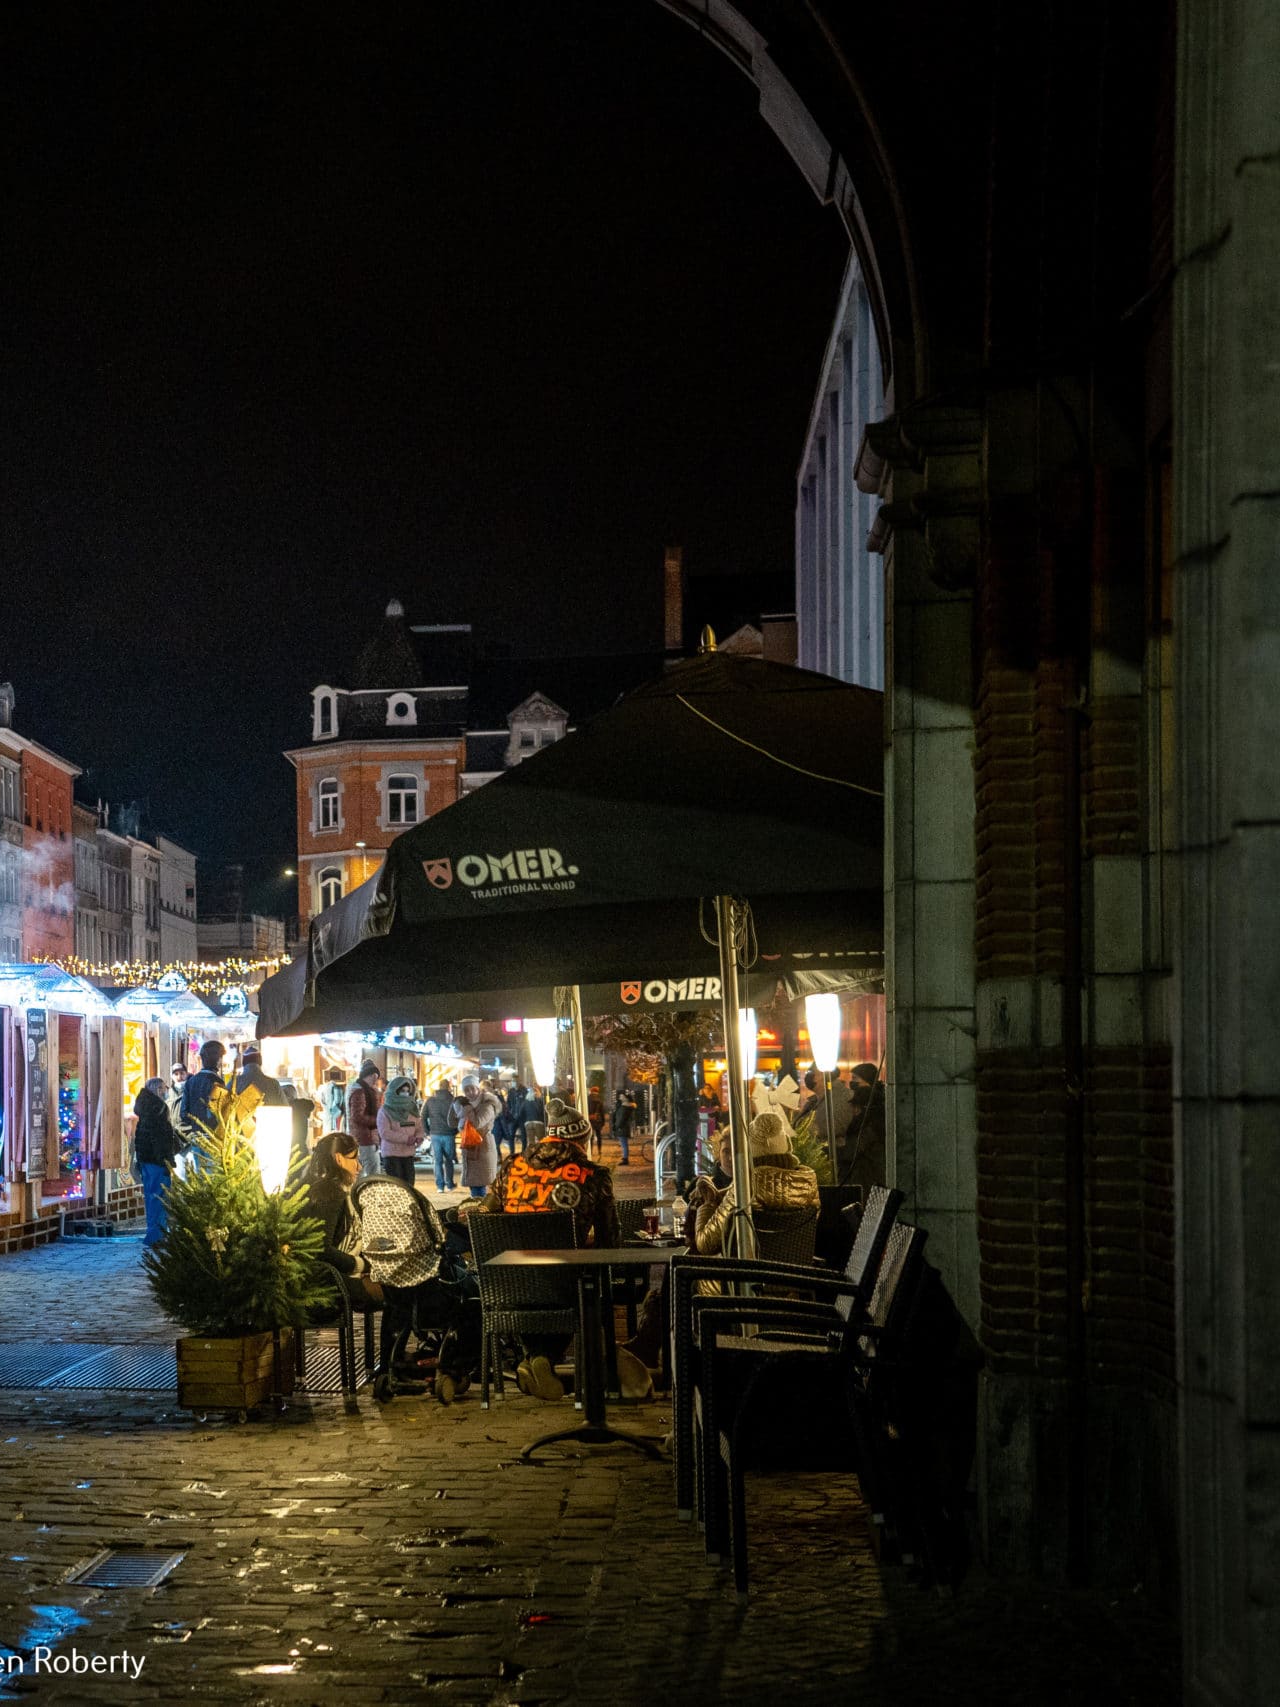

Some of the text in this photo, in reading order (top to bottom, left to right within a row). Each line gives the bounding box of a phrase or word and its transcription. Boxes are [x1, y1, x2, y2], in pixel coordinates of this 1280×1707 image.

[471, 880, 576, 899] TRADITIONAL BLOND
[506, 1175, 554, 1206] Dry
